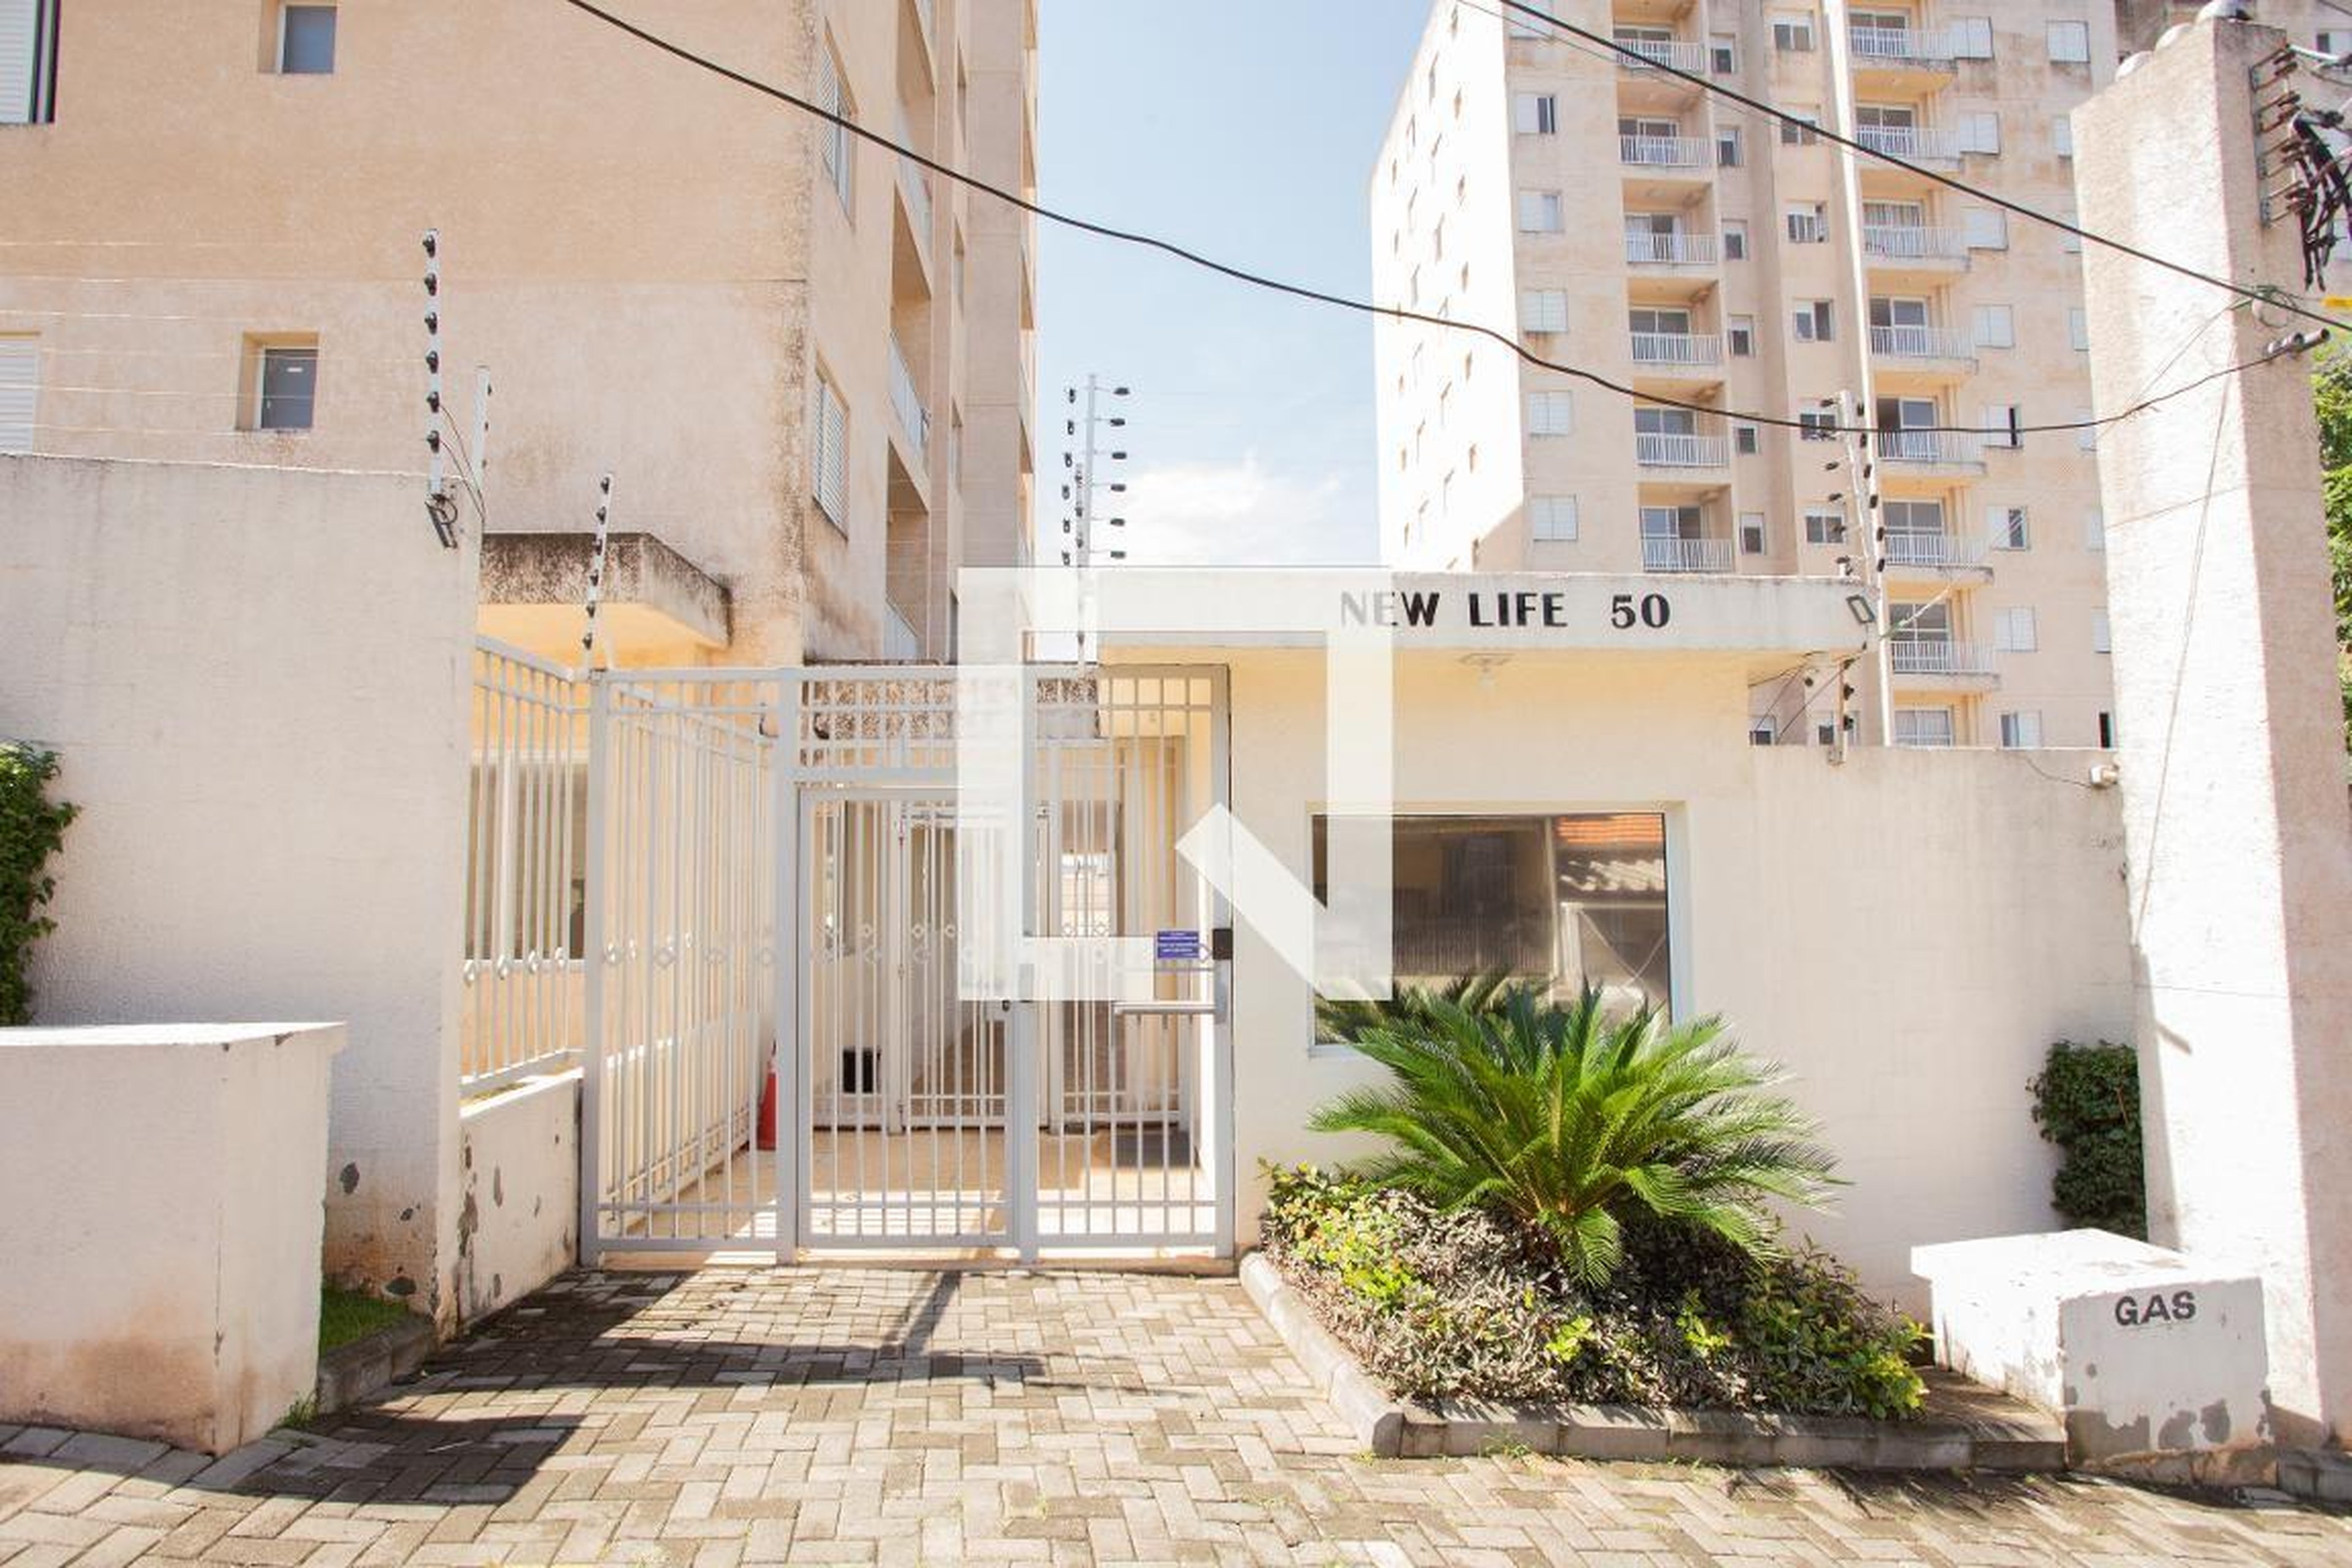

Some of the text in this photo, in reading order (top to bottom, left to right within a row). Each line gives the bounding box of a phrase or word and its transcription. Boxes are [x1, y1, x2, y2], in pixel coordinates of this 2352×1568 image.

[1340, 592, 1671, 629] NEW LIFE 50
[2115, 1290, 2196, 1326] GAS
